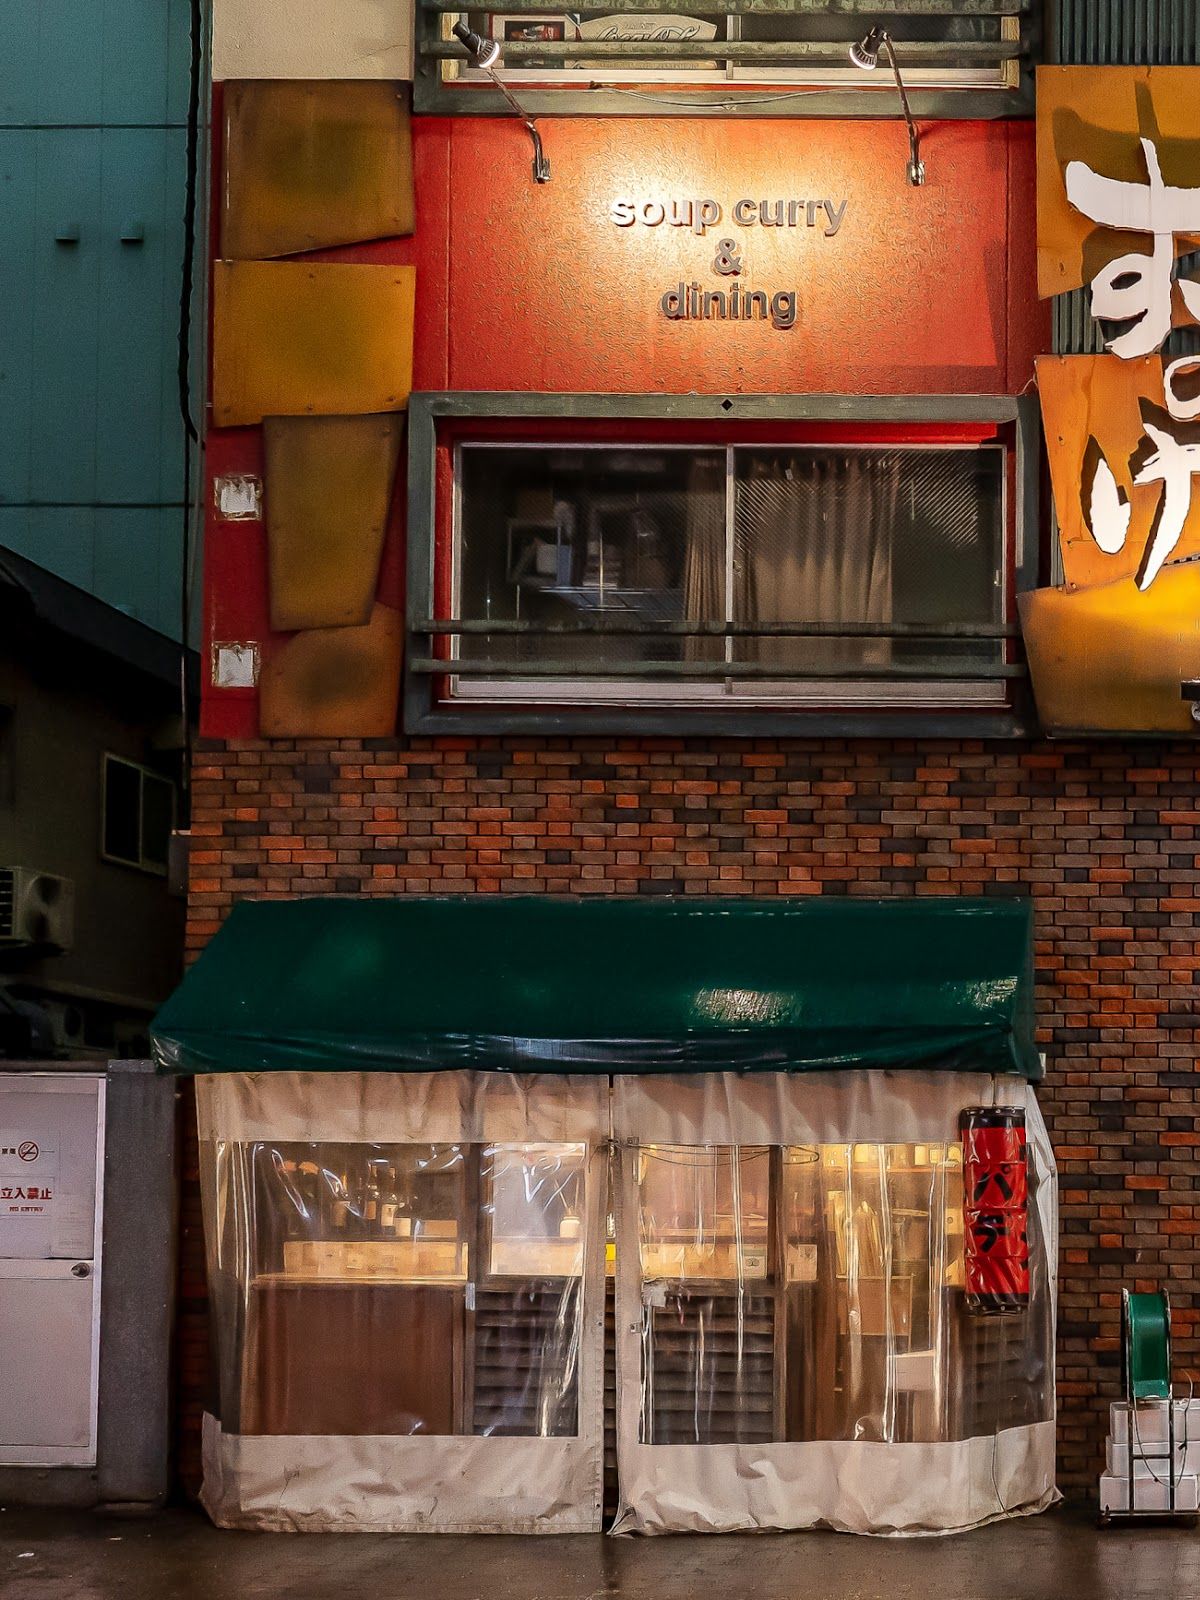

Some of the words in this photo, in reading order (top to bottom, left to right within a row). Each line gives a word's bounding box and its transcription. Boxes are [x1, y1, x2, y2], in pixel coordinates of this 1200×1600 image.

[610, 195, 721, 236] soup
[732, 195, 849, 237] curry
[714, 237, 744, 276] &
[661, 280, 797, 330] dining
[0, 1187, 52, 1200] 立入禁止
